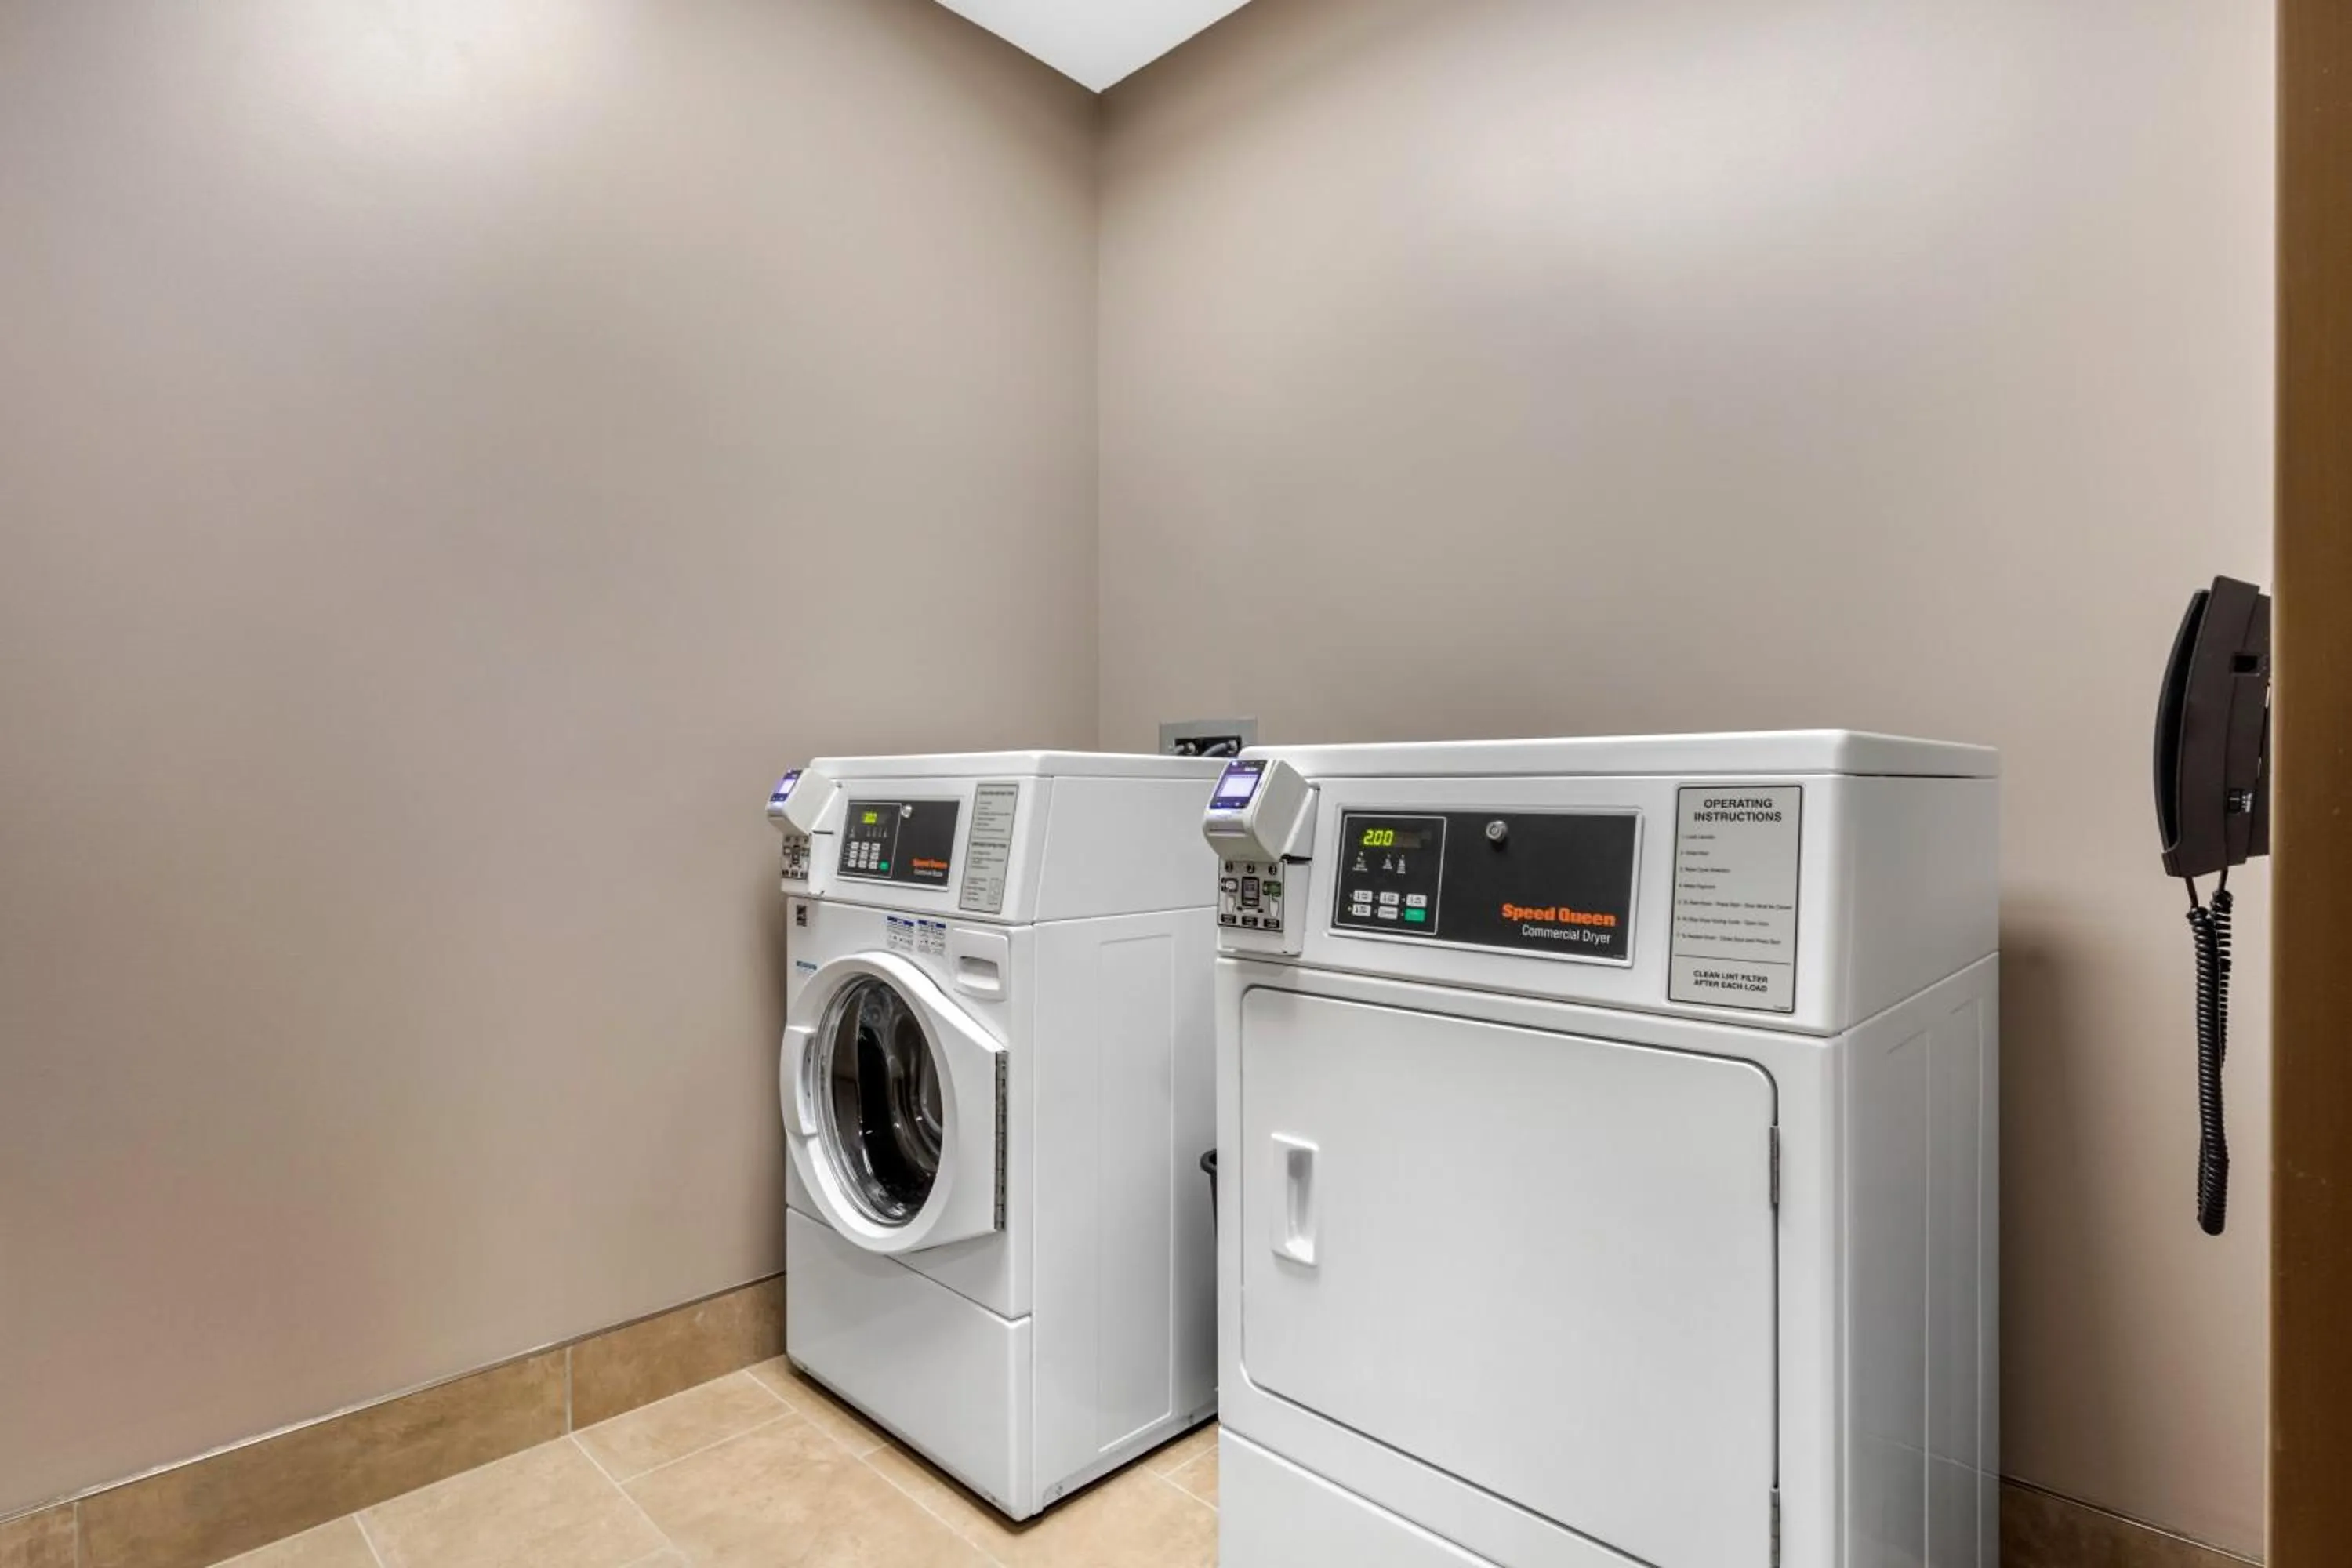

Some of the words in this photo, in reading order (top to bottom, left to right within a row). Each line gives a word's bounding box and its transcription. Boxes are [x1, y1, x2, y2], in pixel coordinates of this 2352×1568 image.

[1704, 798, 1773, 808] OPERATING
[1693, 811, 1782, 822] INSTRUCTIONS
[1501, 902, 1556, 921] Speed
[1558, 907, 1616, 927] Queen
[1521, 924, 1580, 941] Commercial
[1582, 930, 1612, 946] Dryer
[1693, 970, 1720, 979] CLEAN
[1740, 973, 1769, 983] FILTER
[1693, 978, 1719, 988] AFTER
[1720, 981, 1743, 990] EACH
[1744, 983, 1768, 992] LOAD
